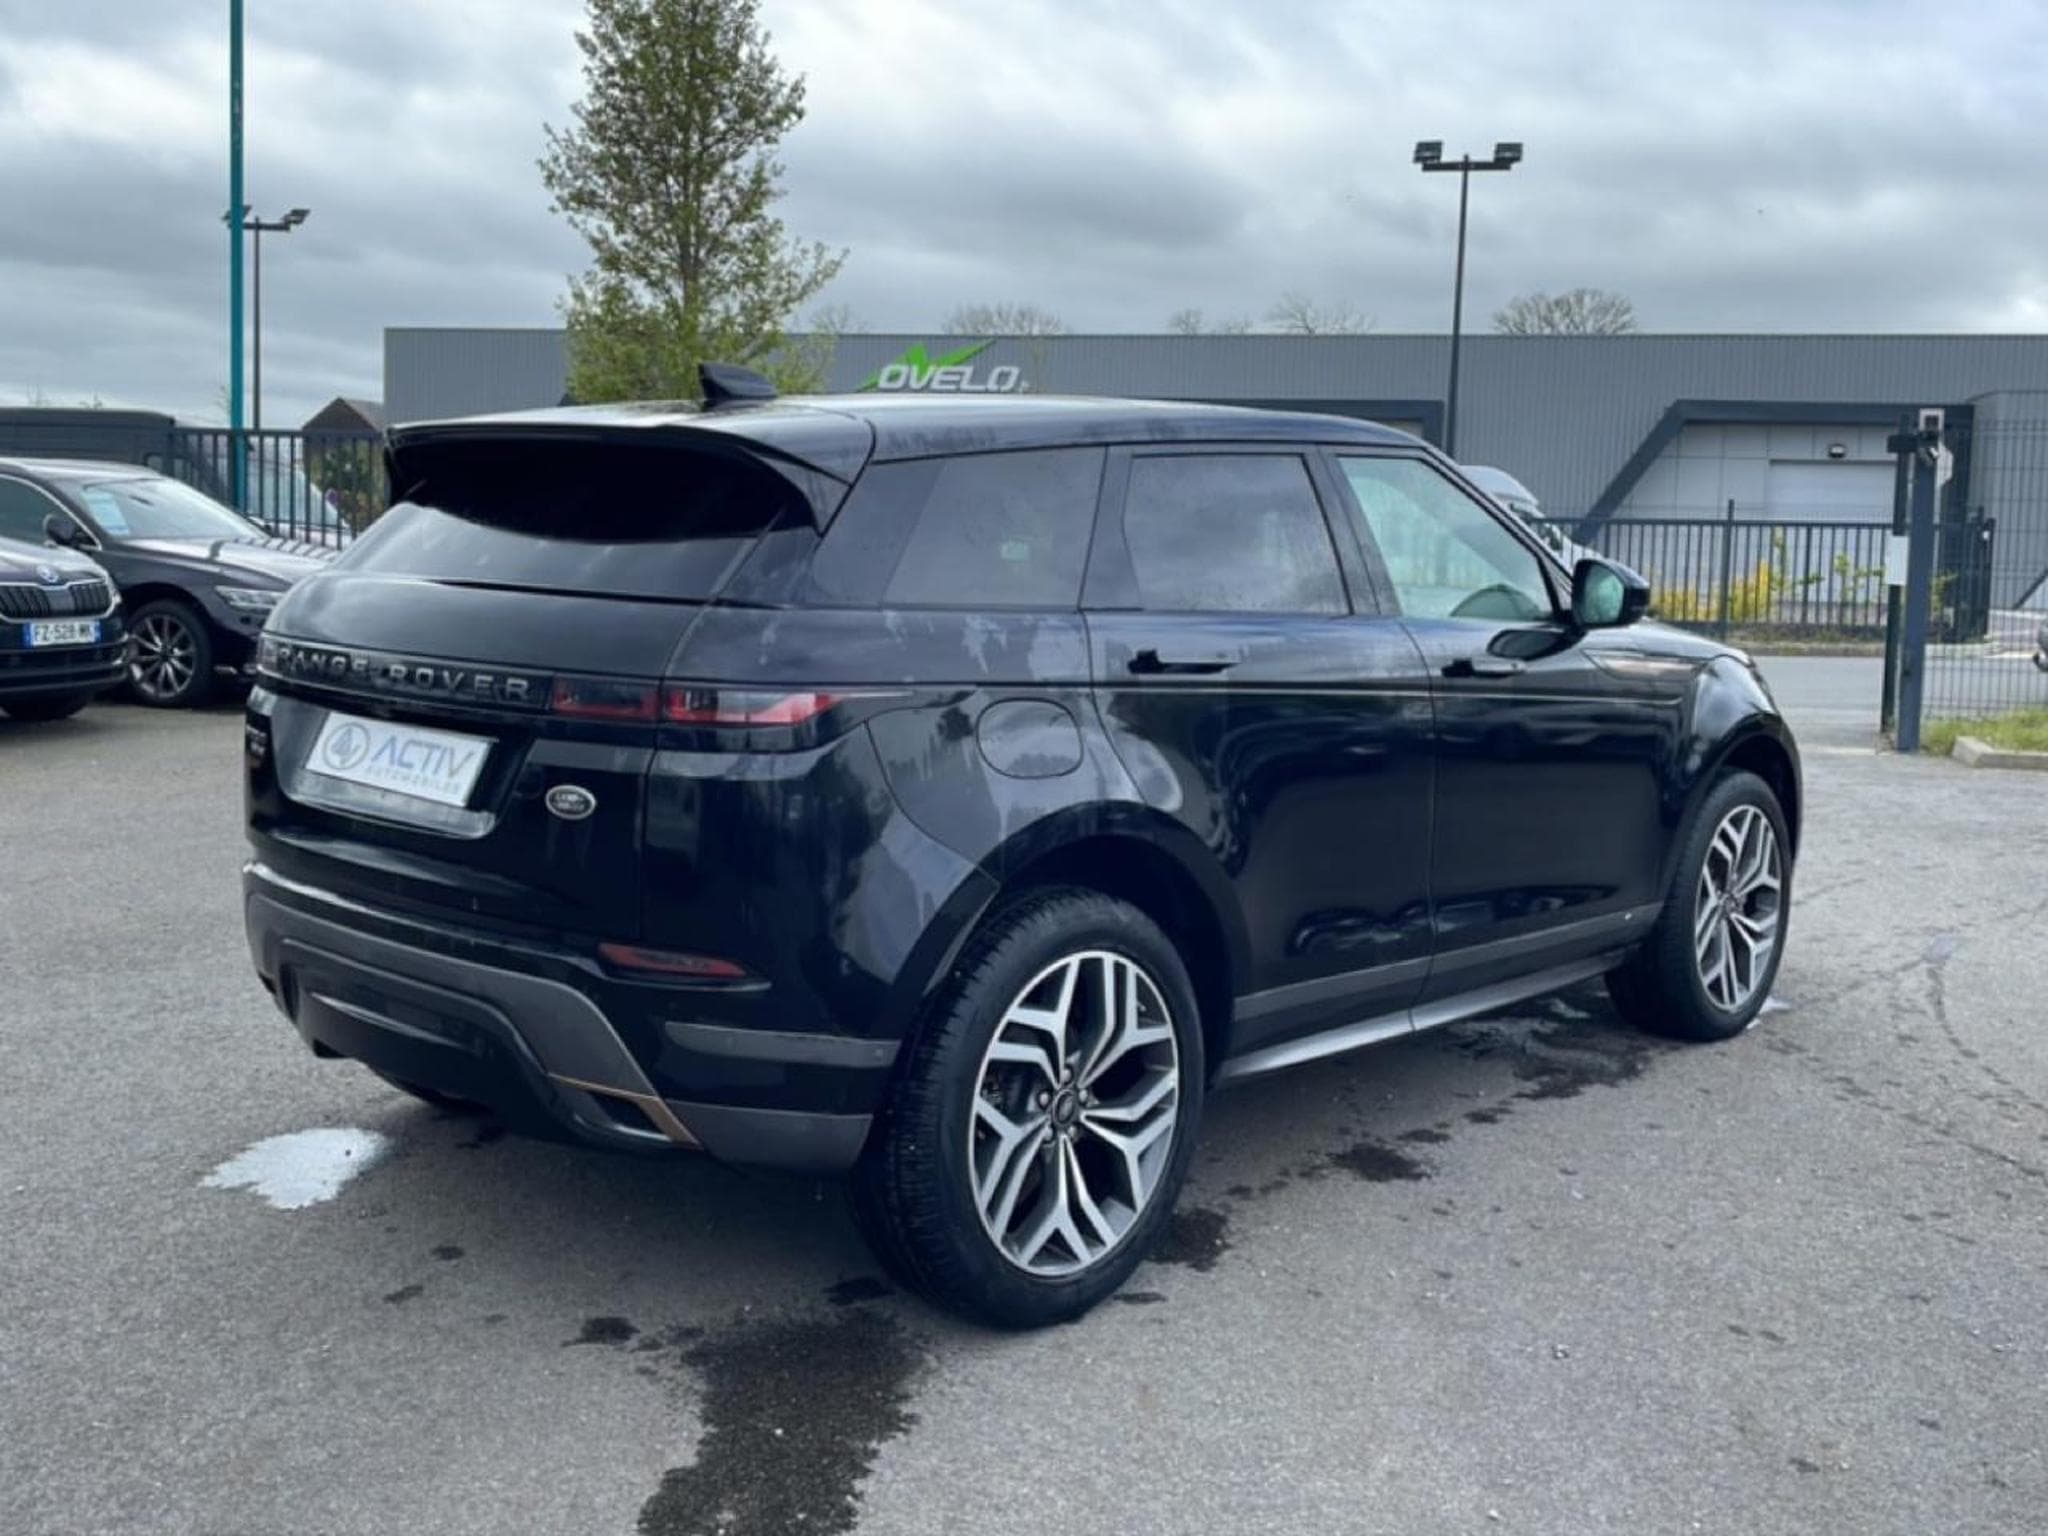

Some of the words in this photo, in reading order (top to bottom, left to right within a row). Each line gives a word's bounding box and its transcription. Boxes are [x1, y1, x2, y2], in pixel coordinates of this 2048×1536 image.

[279, 646, 369, 681] RANGE
[389, 663, 529, 701] ROVER
[370, 735, 474, 778] ACTIV
